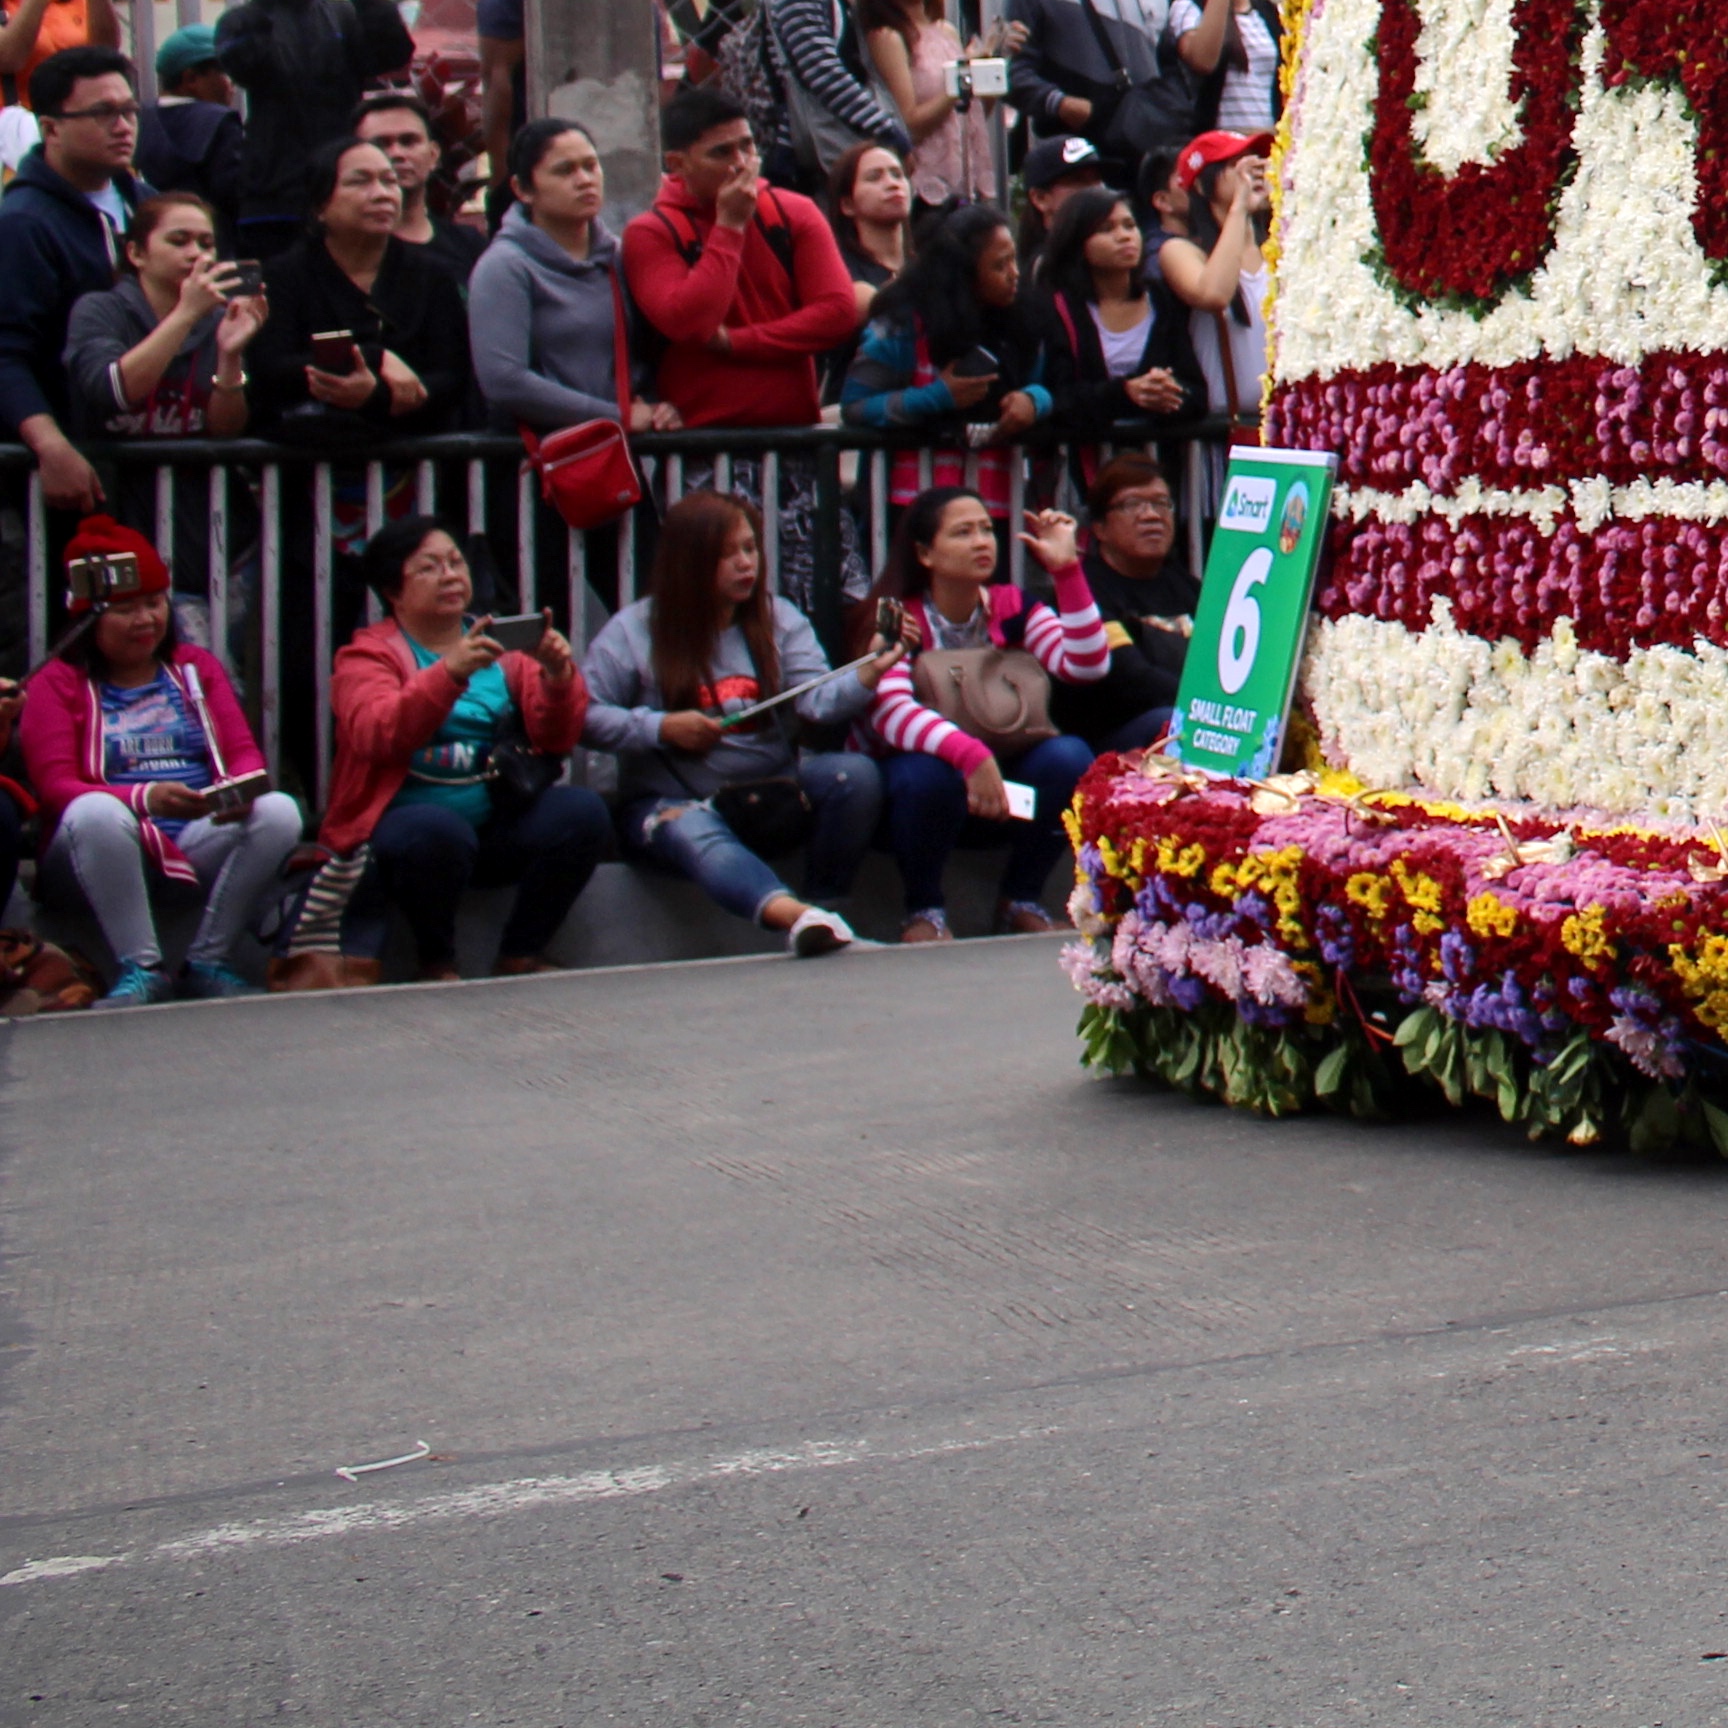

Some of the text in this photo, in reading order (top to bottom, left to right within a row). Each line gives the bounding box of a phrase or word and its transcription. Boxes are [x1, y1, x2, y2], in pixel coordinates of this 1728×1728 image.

[1238, 492, 1269, 521] Smart
[1217, 546, 1275, 696] 6
[1188, 697, 1258, 735] SMALL FLOAT
[1192, 727, 1242, 758] CATEGORY
